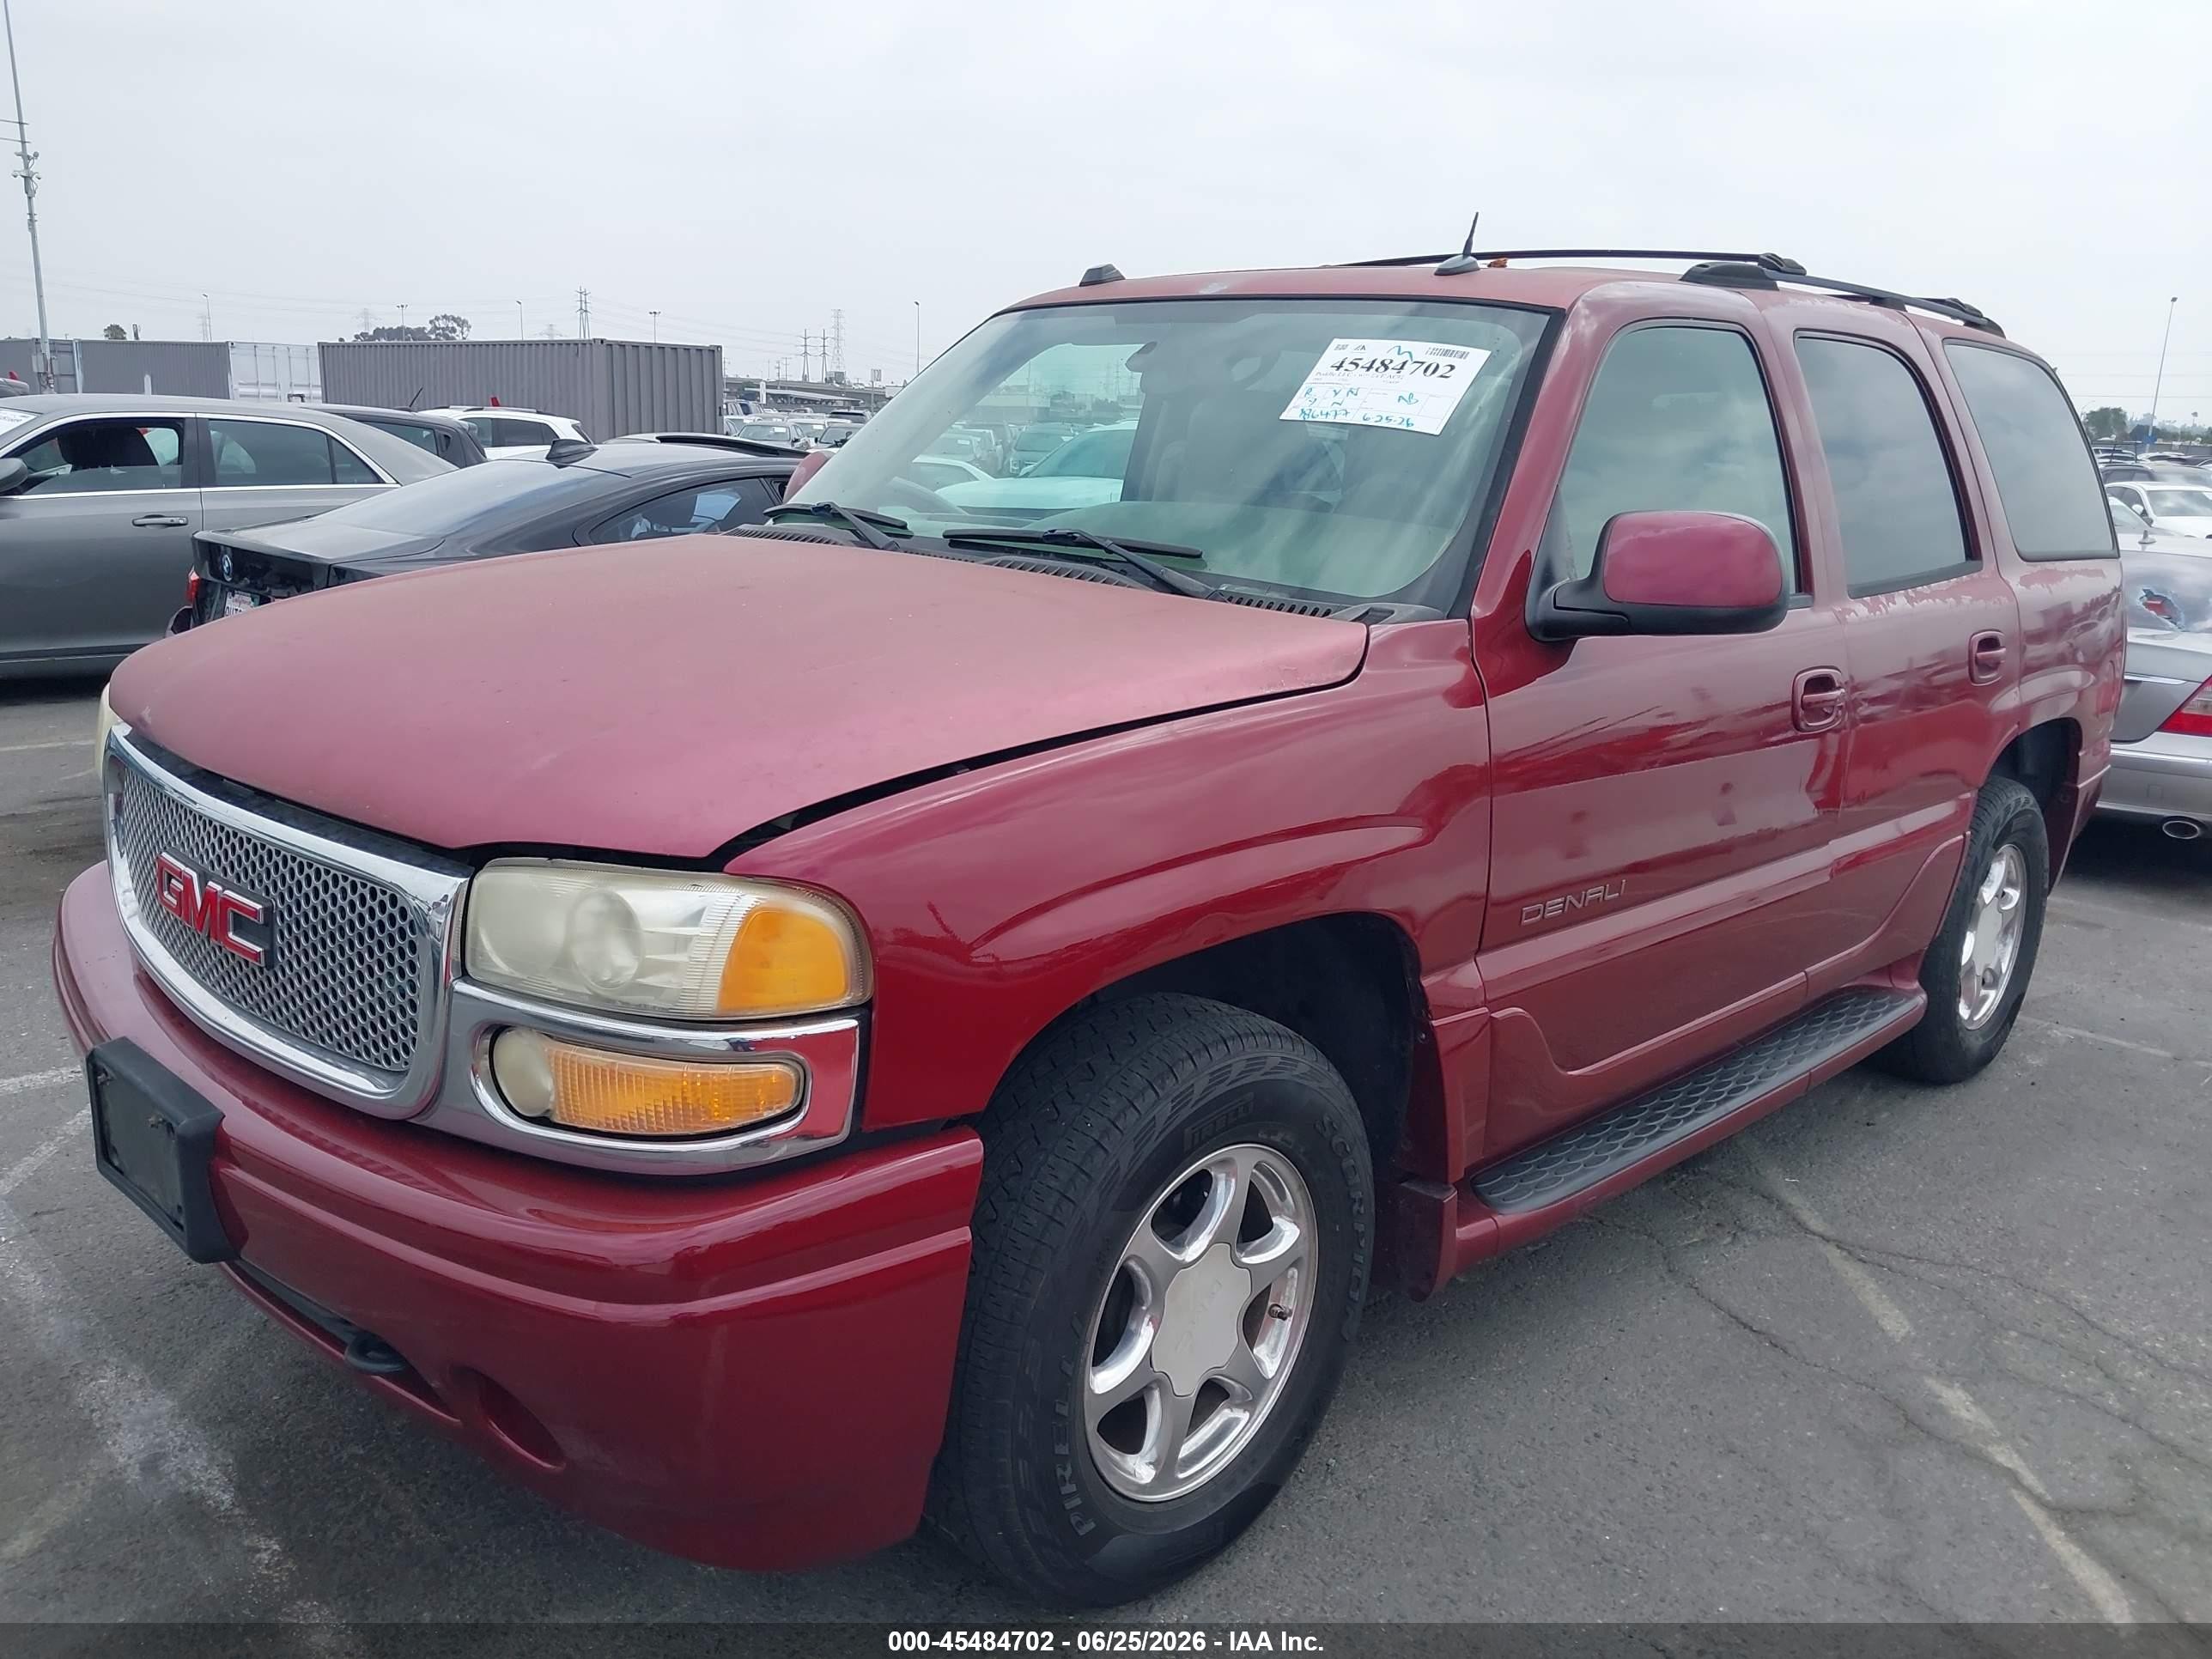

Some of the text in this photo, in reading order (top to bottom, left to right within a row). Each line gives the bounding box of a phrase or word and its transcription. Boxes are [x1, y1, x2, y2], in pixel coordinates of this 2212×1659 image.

[1330, 356, 1456, 379] 45484702
[156, 851, 265, 967] GMC
[1520, 879, 1626, 926] DENALI
[1314, 1115, 1365, 1341] SCORPION
